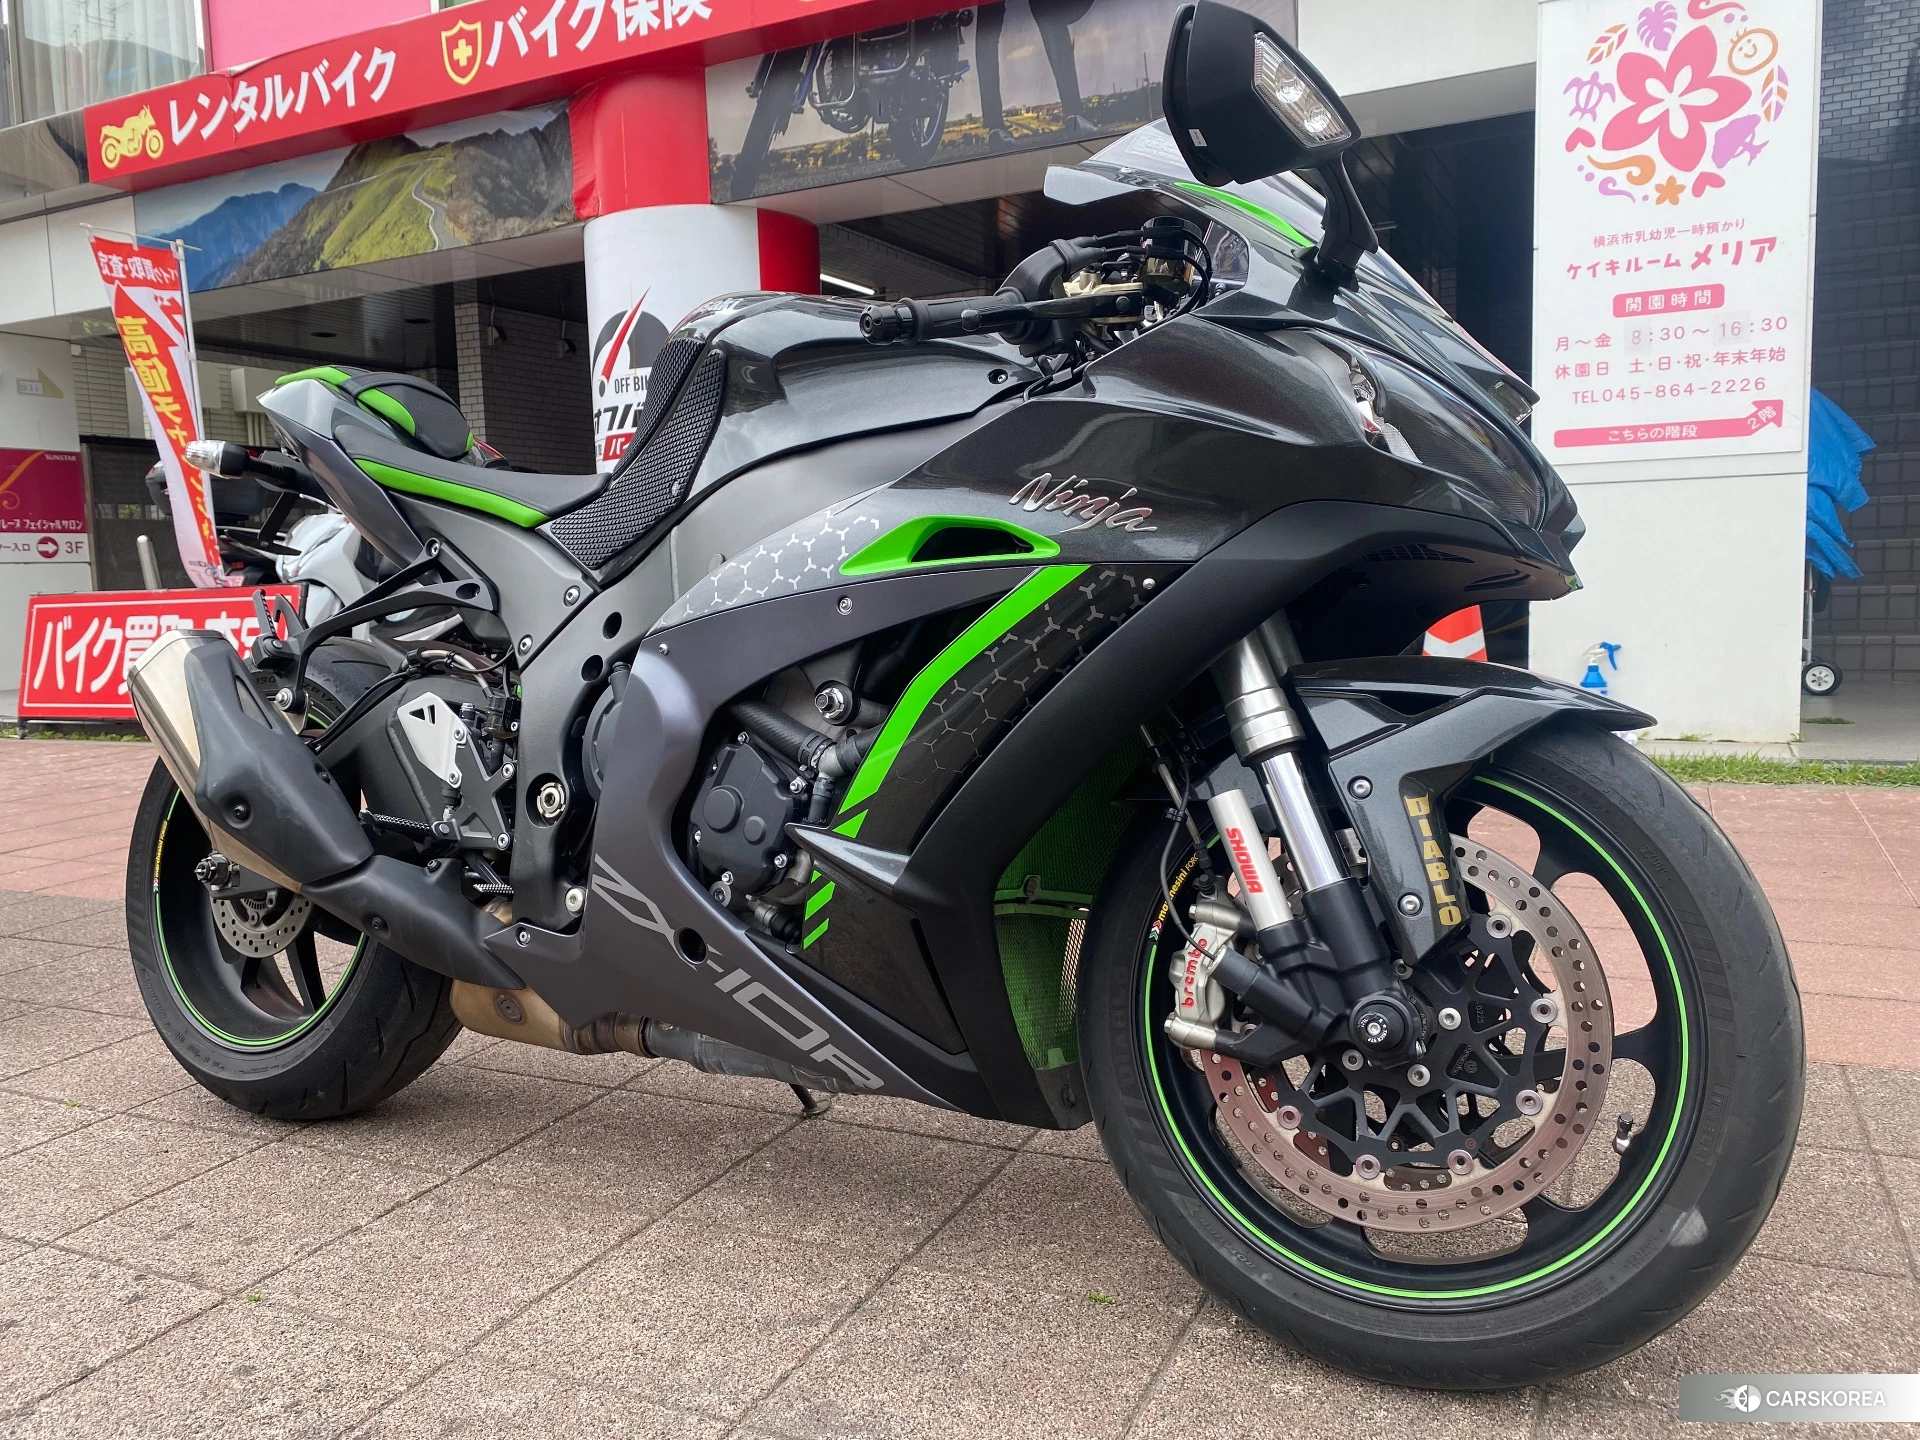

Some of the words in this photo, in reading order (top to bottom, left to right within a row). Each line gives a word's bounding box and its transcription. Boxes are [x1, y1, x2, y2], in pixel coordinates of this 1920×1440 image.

[169, 47, 397, 146] レンタルバイク
[1593, 219, 1745, 248] 横浜市乳幼児一時預かり
[1567, 253, 1681, 280] ケイキルーム
[1691, 237, 1777, 270] メリア
[1625, 289, 1712, 313] 開園時間
[614, 376, 630, 394] OFF
[1555, 362, 1609, 379] 休園日
[1608, 425, 1698, 442] こちらの階段
[1009, 472, 1158, 533] Ninja
[65, 541, 84, 554] 3F
[1225, 827, 1264, 894] SHOWA
[1404, 793, 1462, 926] DIABLO
[1181, 938, 1207, 1009] brembo
